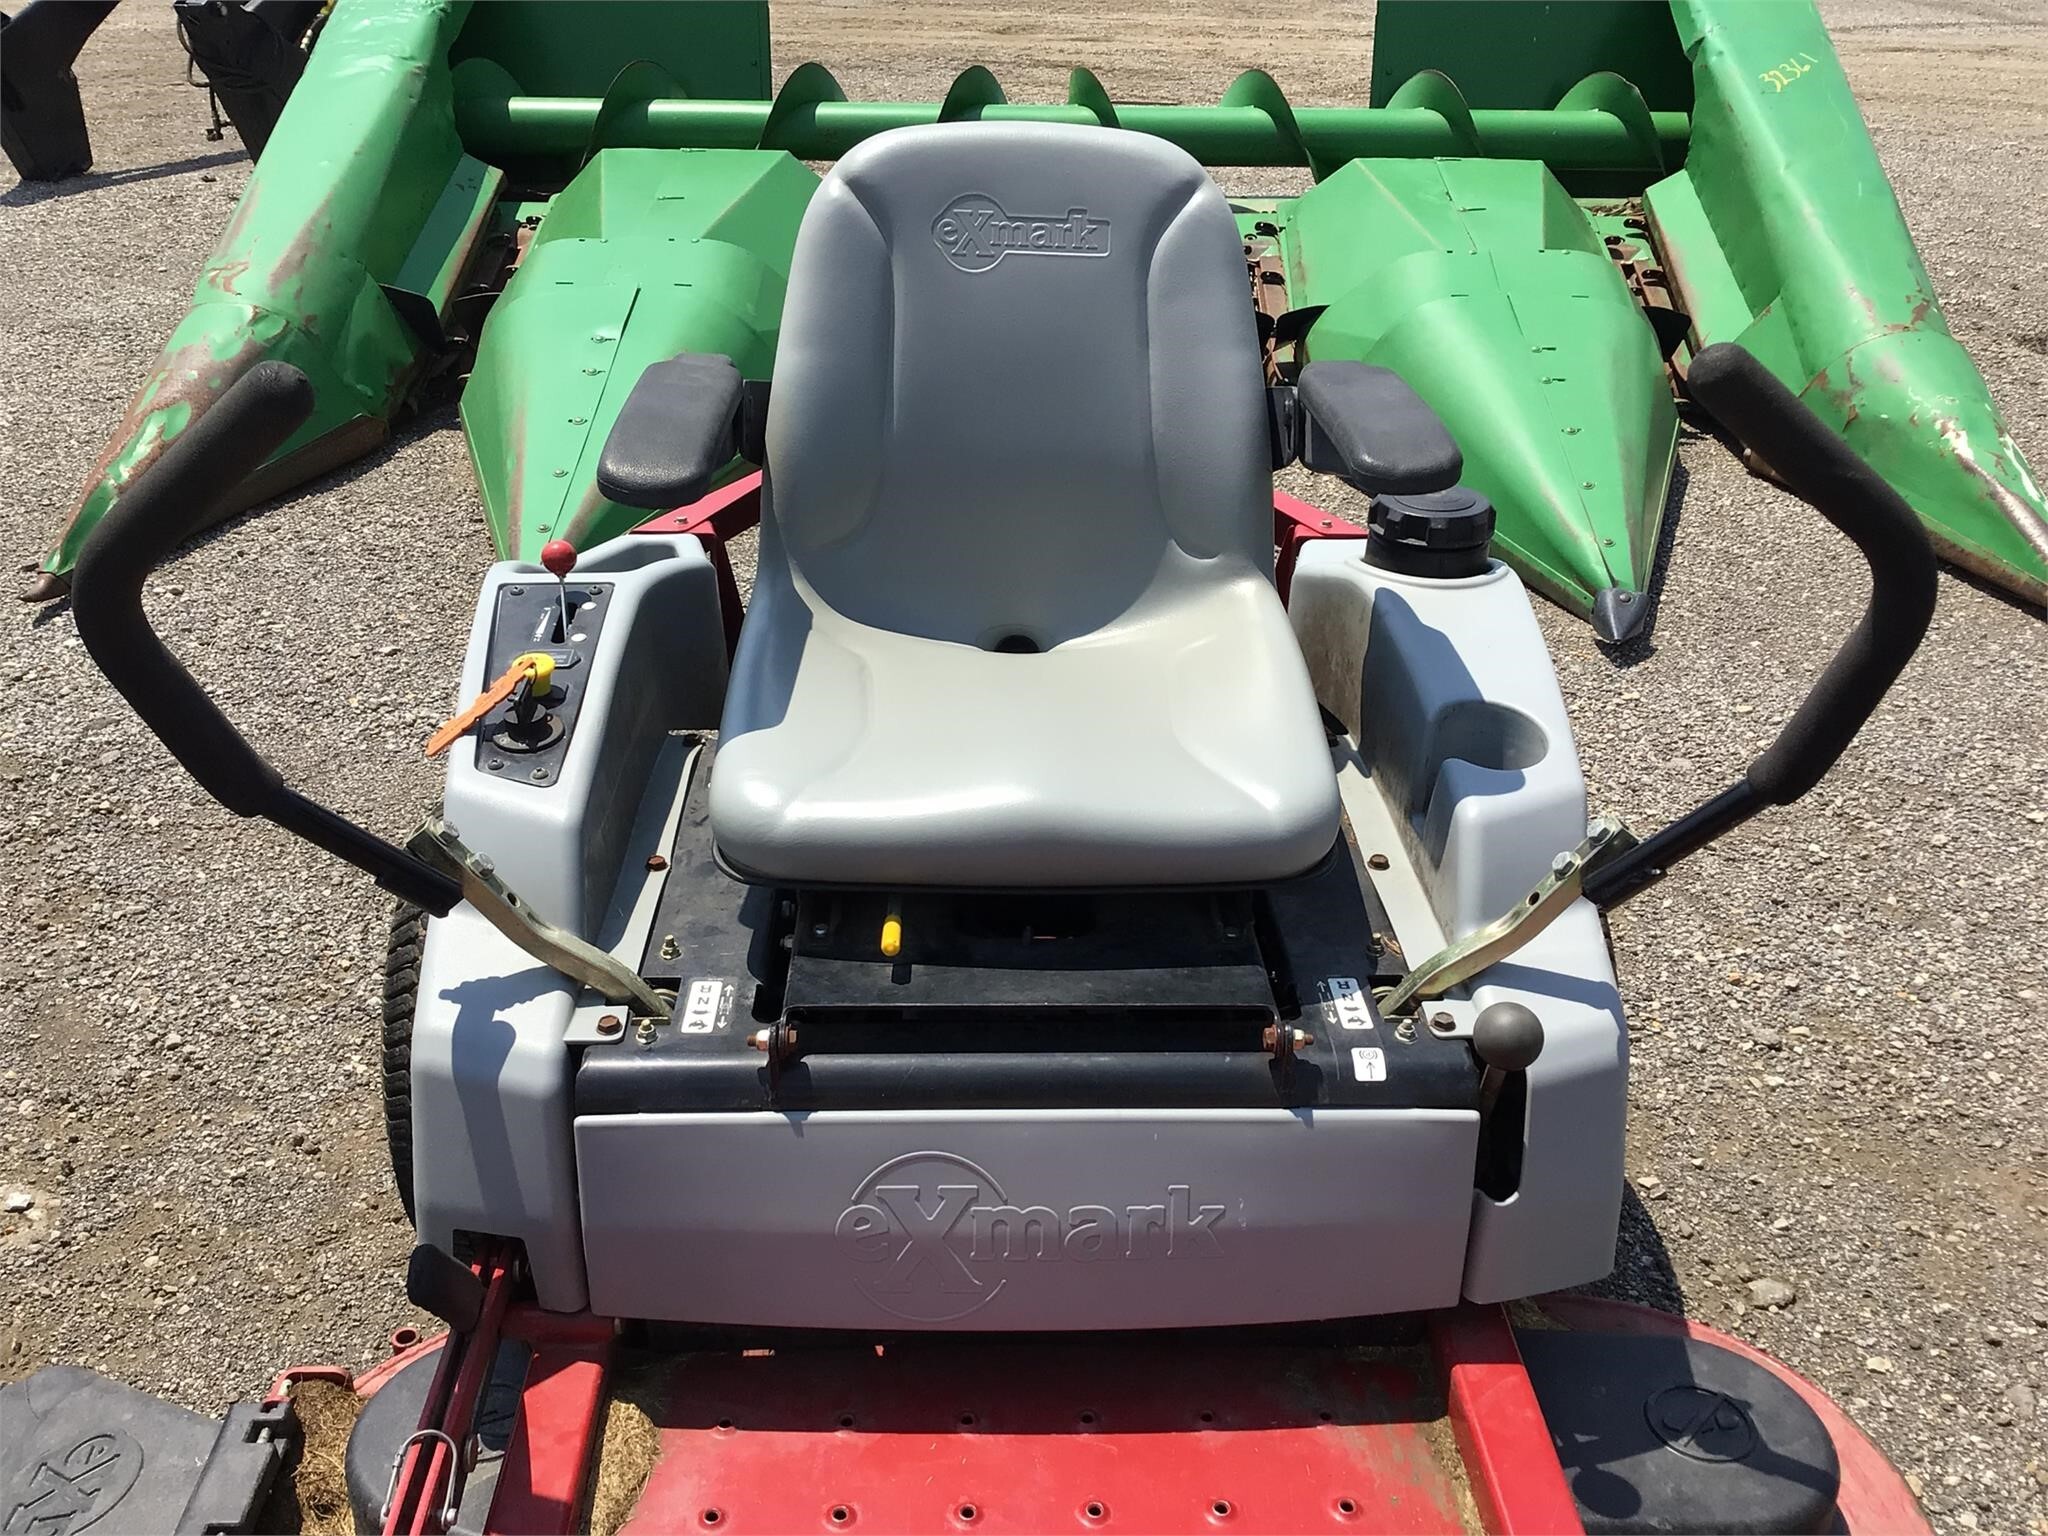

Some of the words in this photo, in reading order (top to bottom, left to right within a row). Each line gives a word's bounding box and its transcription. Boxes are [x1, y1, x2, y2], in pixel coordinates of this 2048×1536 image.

[1758, 52, 1818, 93] 32361
[936, 208, 1098, 258] eXmark
[834, 1184, 1226, 1294] eXmark
